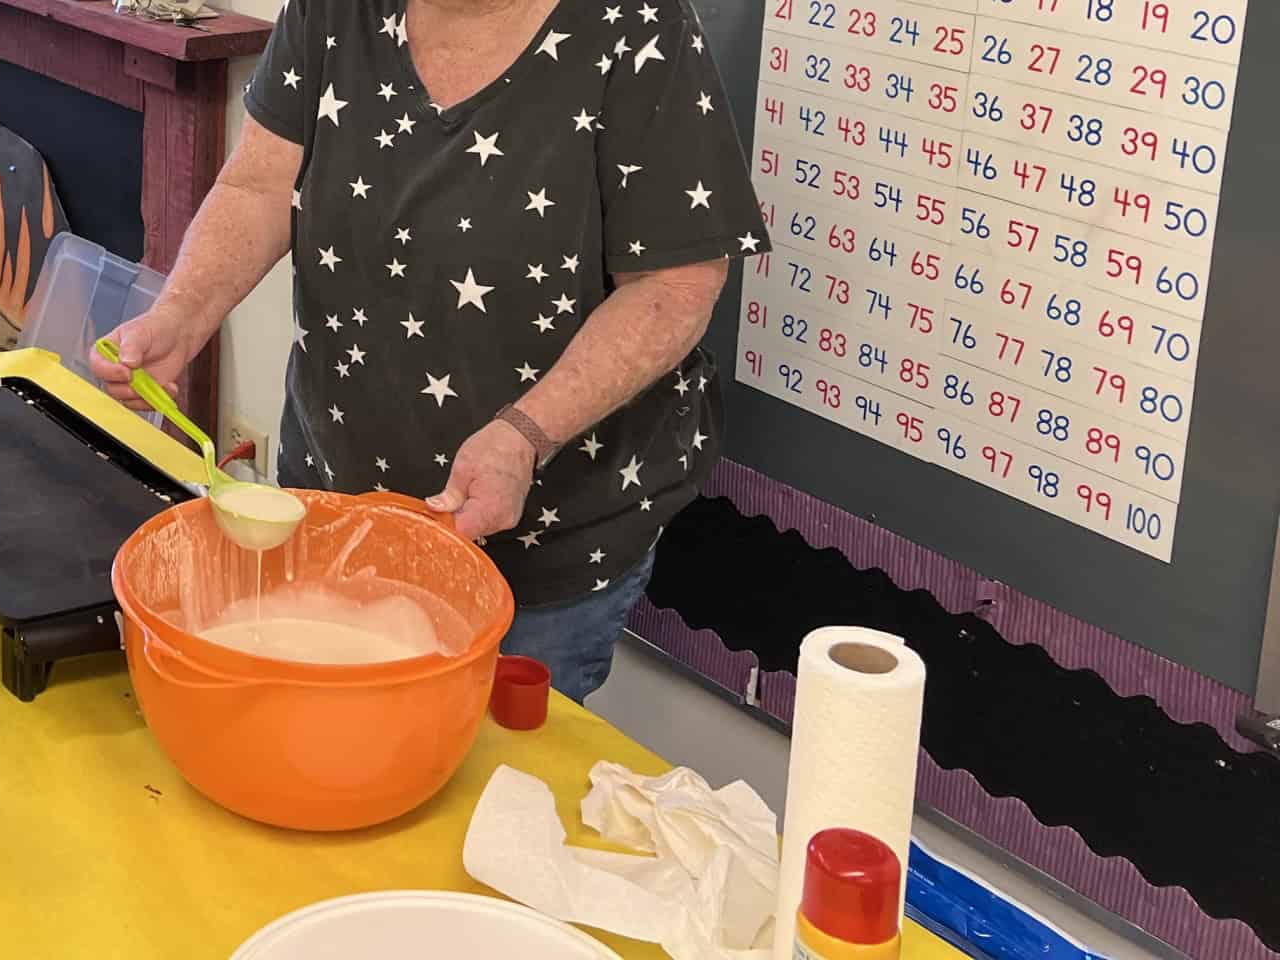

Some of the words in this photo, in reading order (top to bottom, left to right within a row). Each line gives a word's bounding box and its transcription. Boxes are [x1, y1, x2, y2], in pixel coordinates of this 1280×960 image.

[808, 0, 836, 29] 22
[847, 9, 876, 37] 23
[889, 17, 920, 47] 24
[934, 26, 965, 57] 25
[982, 35, 1013, 65] 26
[1027, 44, 1061, 75] 27
[1075, 54, 1112, 86] 28
[1129, 65, 1167, 99] 29
[1181, 76, 1226, 110] 30
[1142, 1, 1169, 33] 19
[1190, 10, 1236, 44] 20
[765, 97, 784, 125] 41
[799, 106, 826, 136] 42
[837, 116, 866, 146] 43
[879, 126, 909, 158] 44
[922, 137, 953, 169] 45
[966, 148, 997, 180] 46
[1013, 160, 1047, 192] 47
[1060, 173, 1096, 207] 48
[1113, 187, 1151, 224] 49
[1164, 201, 1207, 237] 50
[769, 46, 788, 73] 31
[805, 54, 831, 83] 32
[843, 64, 871, 92] 33
[885, 73, 914, 103] 34
[928, 83, 958, 113] 35
[972, 92, 1003, 122] 36
[1020, 103, 1053, 134] 37
[1067, 114, 1103, 146] 38
[1121, 127, 1158, 161] 39
[1172, 138, 1216, 174] 40
[760, 149, 779, 177] 51
[795, 159, 821, 189] 52
[832, 170, 860, 200] 53
[874, 182, 903, 213] 54
[915, 194, 946, 225] 55
[960, 207, 990, 239] 56
[1007, 220, 1039, 252] 57
[1053, 234, 1088, 268] 58
[1106, 249, 1142, 285] 59
[1156, 266, 1199, 301] 60
[790, 212, 816, 241] 62
[828, 224, 855, 253] 63
[868, 237, 898, 267] 64
[911, 251, 941, 280] 65
[954, 264, 984, 294] 66
[1000, 278, 1032, 310] 67
[1046, 293, 1081, 326] 68
[1098, 310, 1134, 345] 69
[1151, 325, 1190, 362] 70
[746, 301, 767, 328] 81
[781, 314, 808, 344] 82
[818, 328, 847, 357] 83
[858, 343, 888, 374] 84
[899, 358, 931, 389] 85
[943, 374, 974, 406] 86
[988, 391, 1021, 423] 87
[1036, 409, 1070, 442] 88
[1085, 427, 1121, 463] 89
[1135, 445, 1176, 481] 90
[787, 262, 811, 293] 72
[825, 274, 850, 304] 73
[866, 289, 892, 320] 74
[907, 302, 934, 334] 75
[949, 317, 977, 349] 76
[995, 332, 1025, 365] 77
[1041, 349, 1072, 383] 78
[1093, 366, 1126, 404] 79
[1139, 386, 1183, 423] 80
[745, 350, 762, 377] 91
[778, 364, 803, 394] 92
[815, 379, 841, 409] 93
[855, 395, 882, 426] 94
[896, 412, 924, 443] 95
[937, 428, 966, 460] 96
[982, 446, 1013, 478] 97
[1028, 465, 1060, 498] 98
[1076, 484, 1111, 521] 99
[1126, 504, 1161, 540] 100
